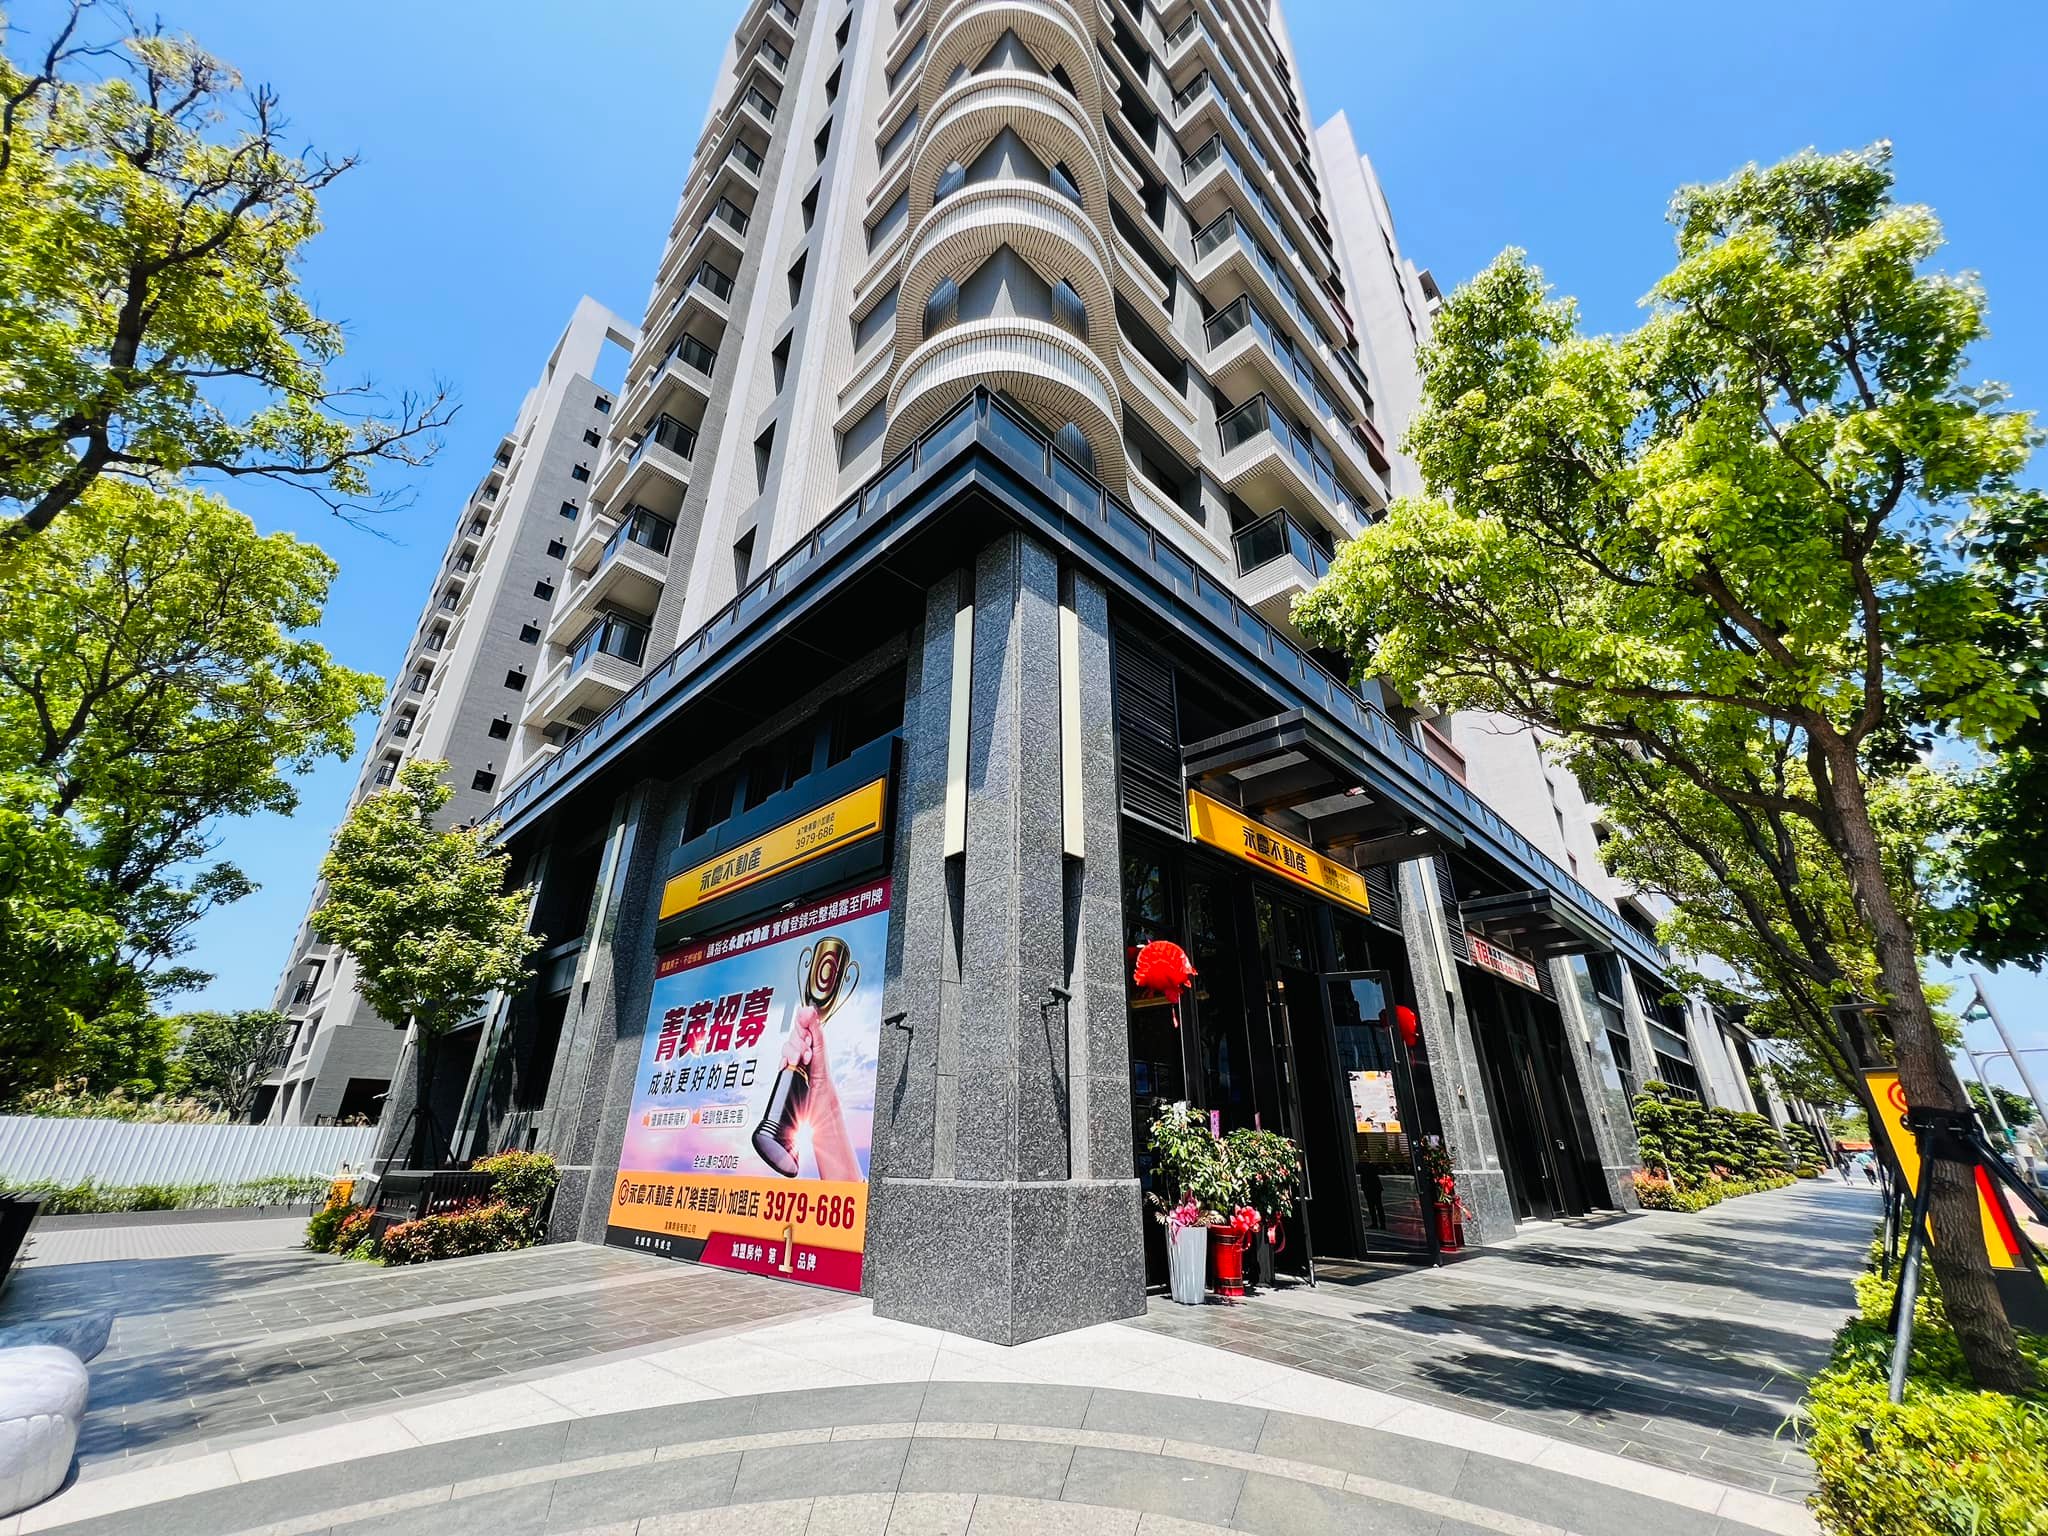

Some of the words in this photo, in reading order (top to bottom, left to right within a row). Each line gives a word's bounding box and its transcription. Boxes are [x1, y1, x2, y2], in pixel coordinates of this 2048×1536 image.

[795, 824, 834, 849] 3979-686
[1242, 825, 1308, 875] 永慶不動產
[700, 846, 762, 891] 永慶不動產
[655, 986, 774, 1062] 菁英招募
[648, 1059, 757, 1096] 成就更好的自己
[629, 1184, 675, 1207] 永慶不動產
[763, 1190, 855, 1229] 3979-686
[797, 1252, 816, 1271] 品牌
